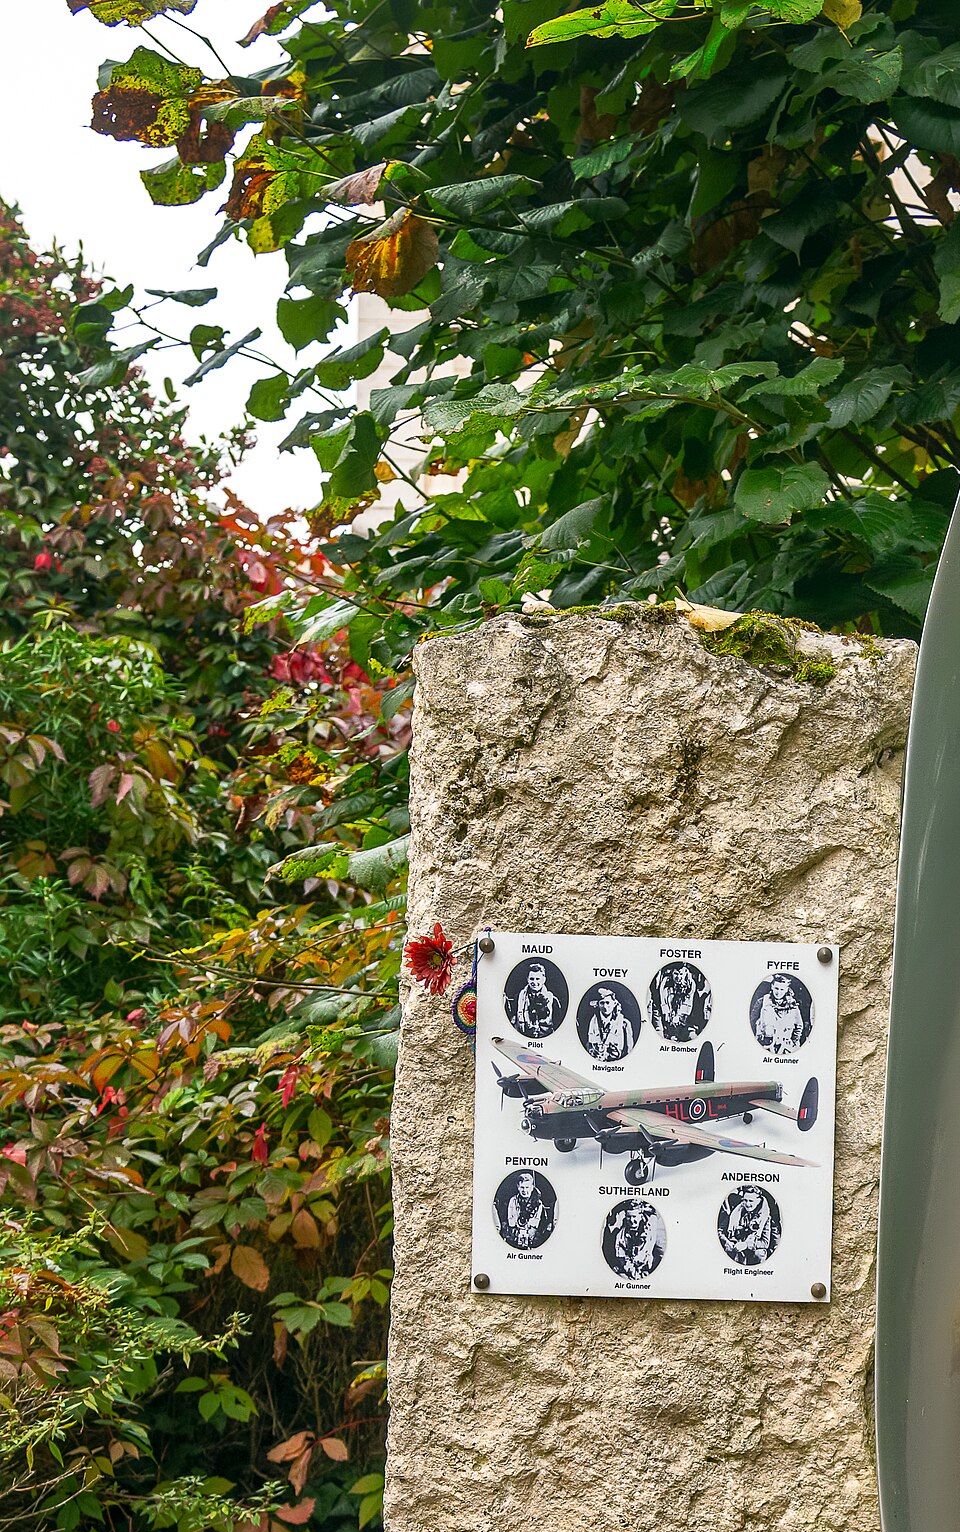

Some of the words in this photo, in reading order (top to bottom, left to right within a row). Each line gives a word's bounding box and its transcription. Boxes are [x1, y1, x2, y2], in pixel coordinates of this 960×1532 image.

[521, 944, 553, 954] MAUD
[659, 949, 702, 959] FOSTER
[767, 961, 800, 971] FYFFE
[593, 968, 628, 978] TOVEY
[527, 1041, 543, 1049] Pilot
[774, 1057, 799, 1065] Gunner
[592, 1064, 625, 1073] Navigator
[505, 1156, 549, 1167] PENTON
[721, 1172, 780, 1183] ANDERSON
[598, 1186, 670, 1197] SUTHERLAND
[506, 1252, 517, 1260] Air
[723, 1267, 743, 1276] Flight
[744, 1268, 774, 1277] Engineer
[614, 1282, 625, 1290] Air
